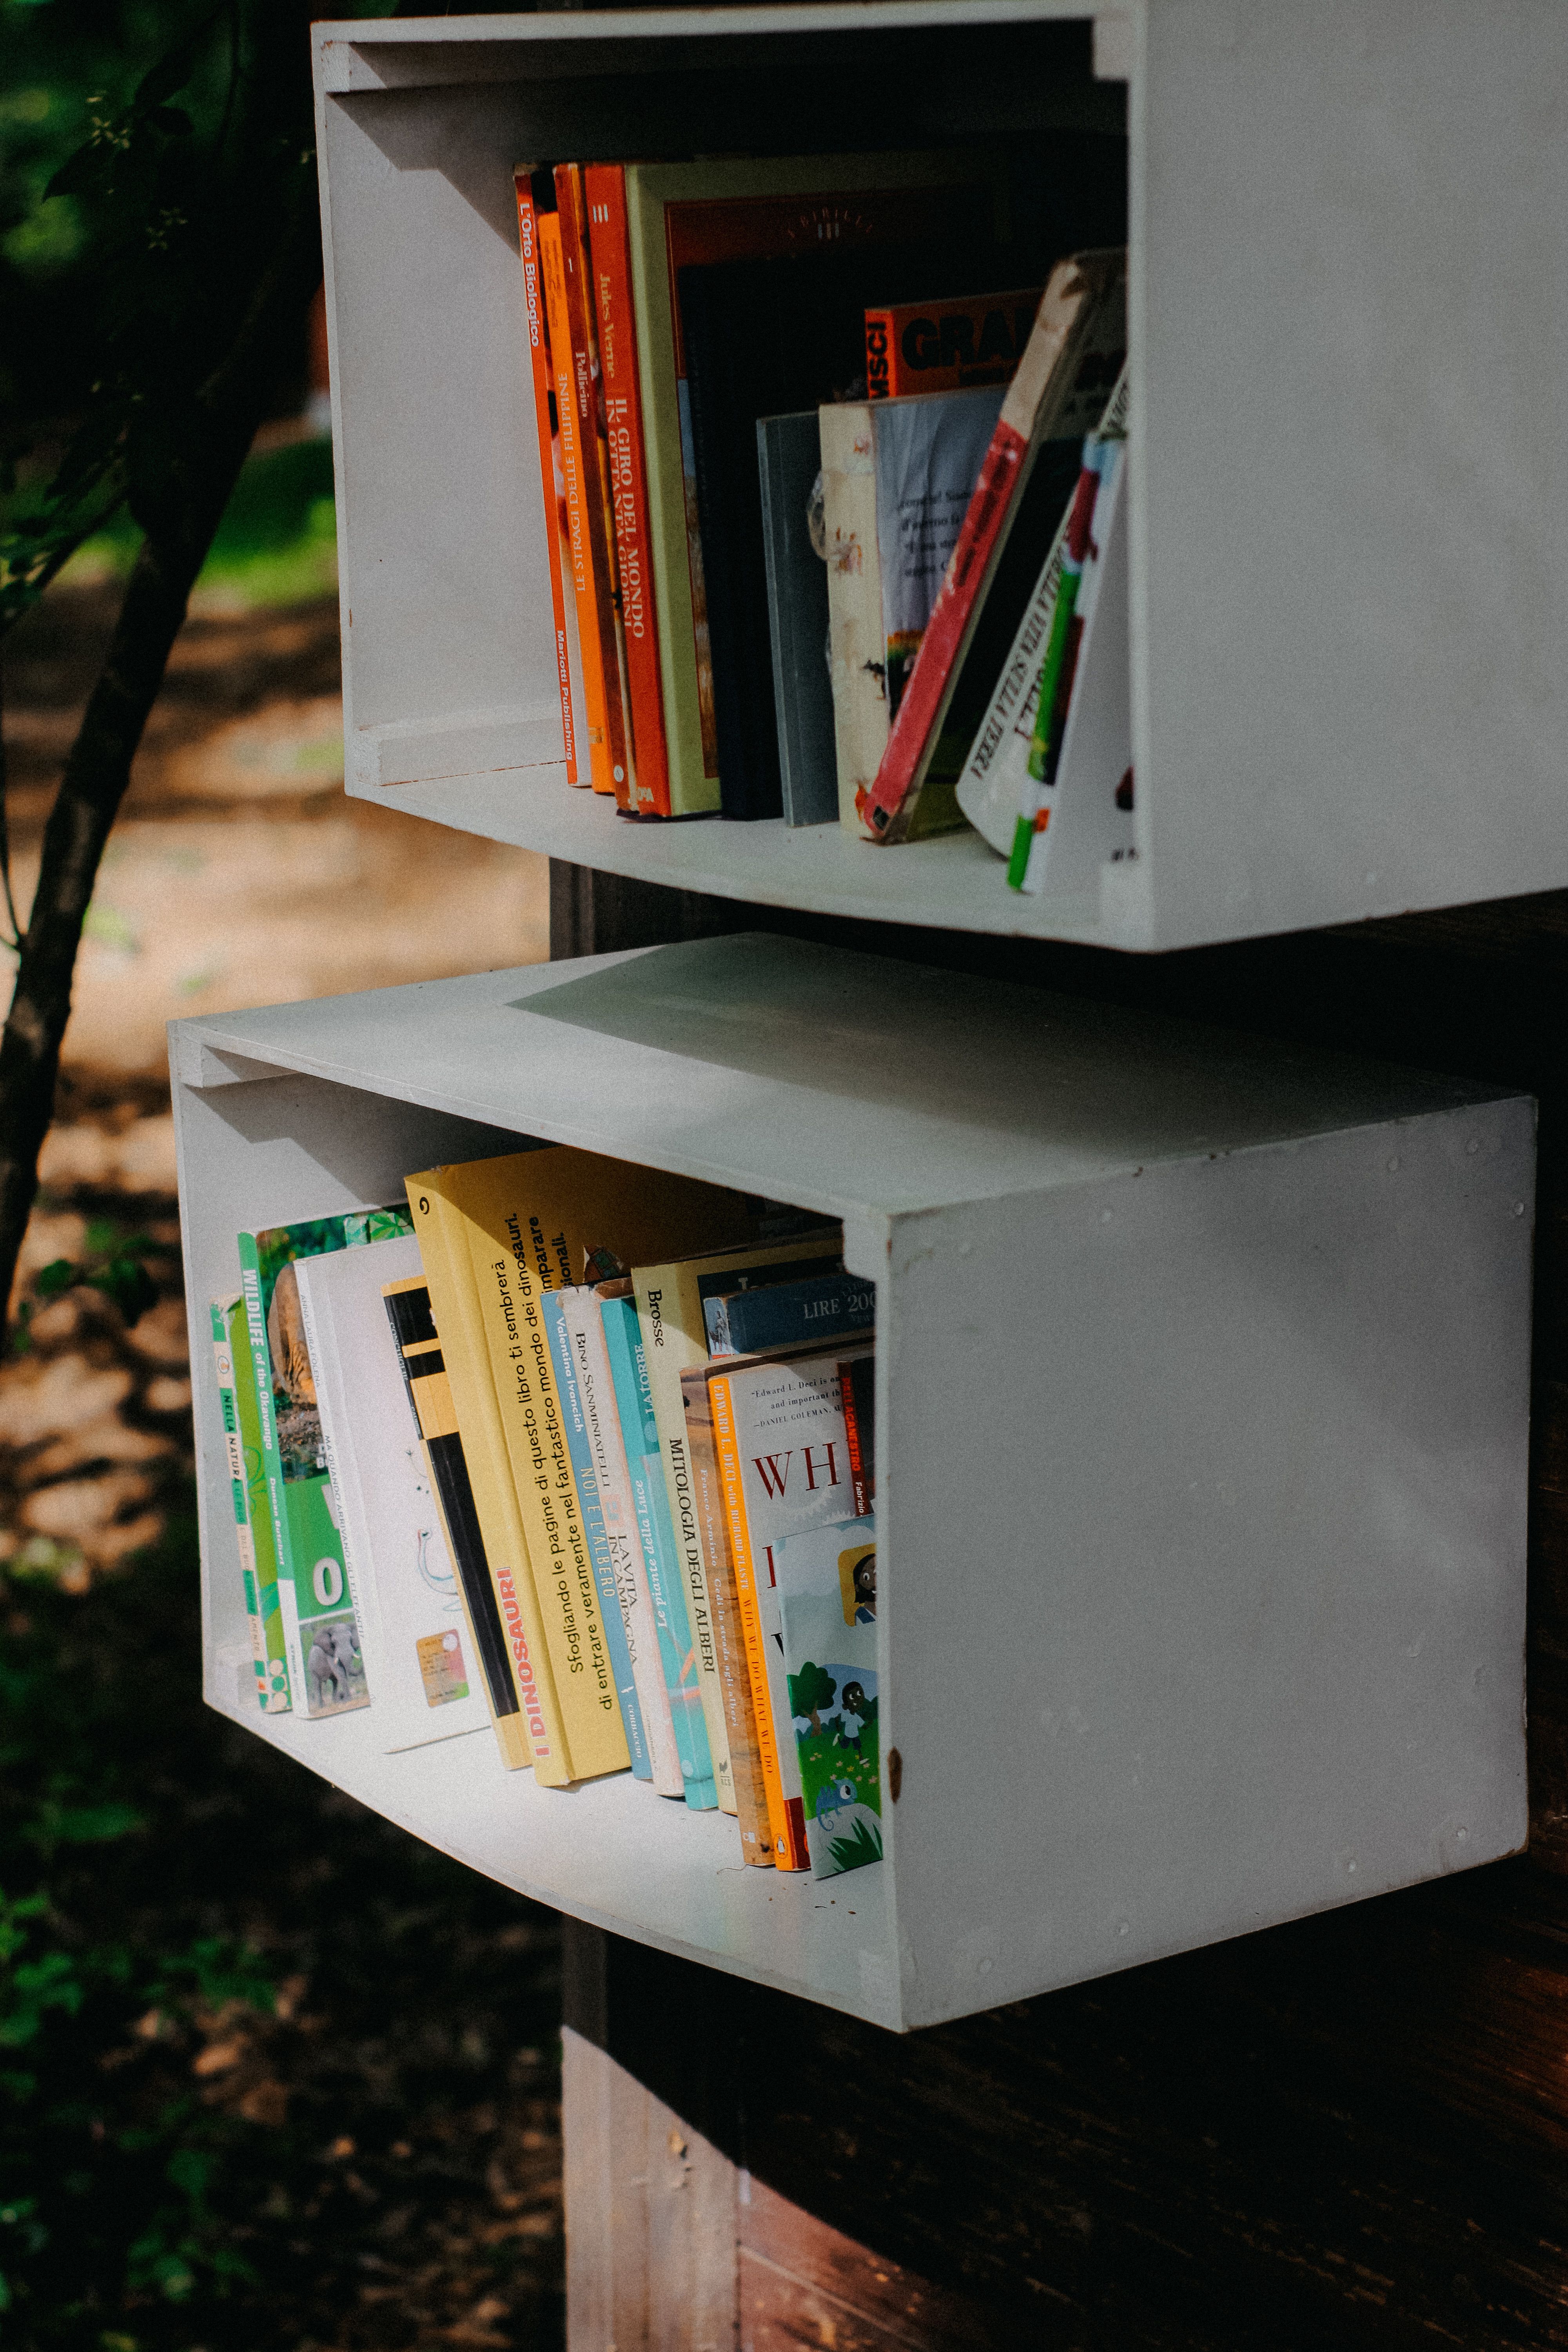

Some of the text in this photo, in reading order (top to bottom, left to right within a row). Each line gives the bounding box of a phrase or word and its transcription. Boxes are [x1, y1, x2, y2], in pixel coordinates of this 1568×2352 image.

[525, 263, 540, 347] Biologico
[599, 273, 617, 379] Jules Verne
[575, 352, 590, 417] Pollicino
[558, 372, 585, 591] LE STRAGI DELLE FILIPPINE
[606, 398, 633, 627] IN OTTANTA GIORNI
[614, 398, 644, 638] IL GIRO DEL MONDO
[557, 630, 572, 760] Mariotti Publishing
[971, 718, 1003, 779] TERRA
[528, 1216, 557, 1293] imparare
[299, 1294, 321, 1388] ANNA LAURA FOLENA
[575, 1332, 591, 1370] BINO
[647, 1289, 668, 1347] Brosse
[803, 1298, 840, 1319] LIRE
[242, 1269, 274, 1450] WILDLIFE of the Okavango
[556, 1316, 584, 1432] Valentina Ivancich
[771, 1400, 785, 1409] and
[789, 1393, 829, 1405] important
[799, 1379, 817, 1388] Deci
[224, 1394, 241, 1483] NELLA NATURA
[323, 1434, 333, 1450] MA
[490, 1258, 586, 1673] Sfogliando le pagine di questo libro ti sembrerà
[503, 1213, 613, 1711] di entrare veramente nel fantastico mondo dei dinosauri.
[751, 1442, 841, 1500] WH
[841, 1377, 861, 1471] PALLACANESTRO
[326, 1454, 341, 1501] QUANDO
[700, 1468, 718, 1566] Franco Arminio
[713, 1384, 750, 1590] EDWARD L. DECI with RICHARD FLASTE
[855, 1481, 866, 1513] Fabrizio
[336, 1503, 350, 1553] ARRIVANO
[580, 1466, 616, 1598] NOI E L'ALBERO
[617, 1534, 638, 1608] LA VITA
[633, 1479, 667, 1627] Le piante della Luce
[669, 1437, 715, 1674] MITOLOGIA DEGLI ALBERI
[608, 1535, 638, 1665] IN CAMPAGNA
[495, 1568, 550, 1757] I DINOSAURI
[713, 1578, 739, 1727] Cedi la strada agli alberi
[742, 1598, 775, 1772] WHY WE DO WHAT WE DO
[628, 1704, 642, 1758] CORBACCIO
